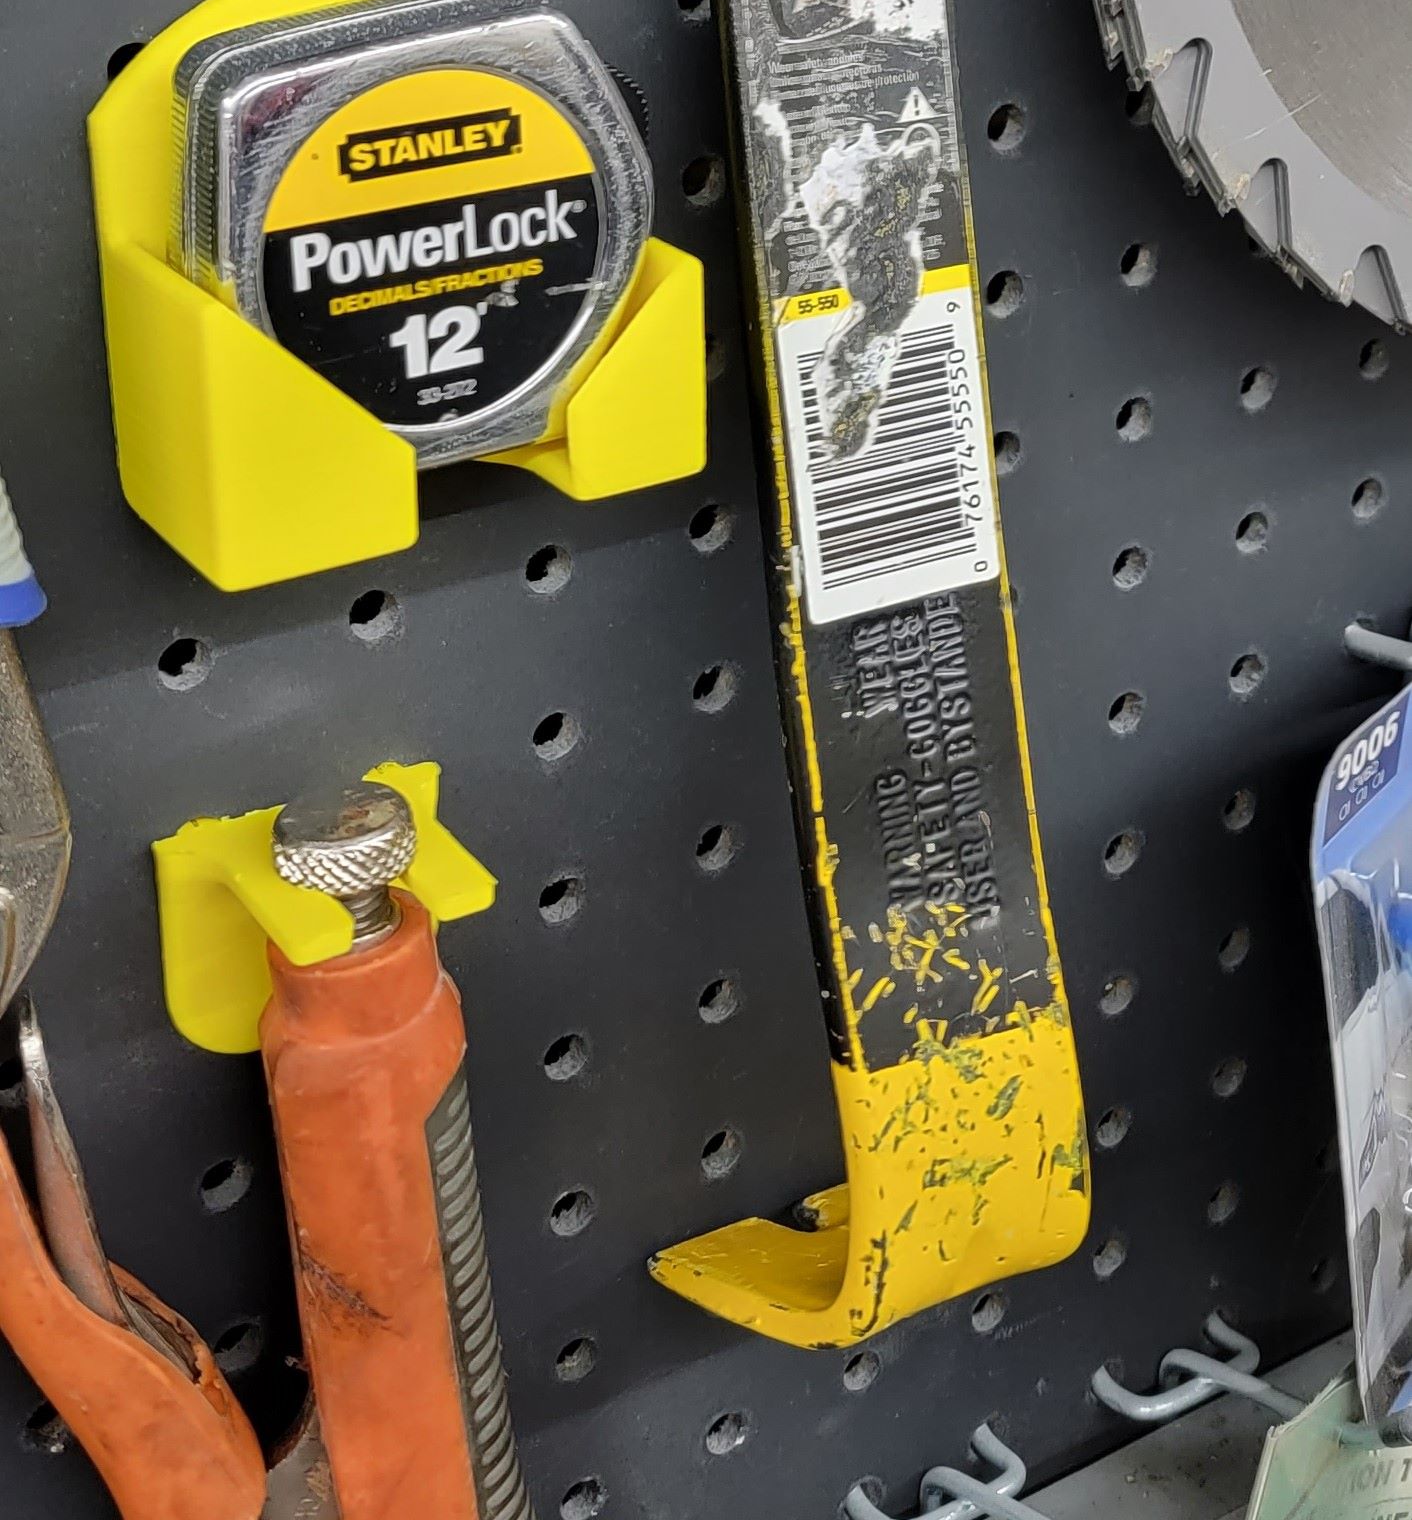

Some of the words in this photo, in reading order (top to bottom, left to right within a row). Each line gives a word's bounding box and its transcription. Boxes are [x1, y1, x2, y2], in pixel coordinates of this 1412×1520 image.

[349, 119, 510, 172] STANLEY
[289, 189, 580, 293] PowerLock
[798, 294, 839, 315] 55-550
[947, 348, 973, 431] 55550
[853, 617, 900, 720] WEAR
[1335, 711, 1400, 791] 9006
